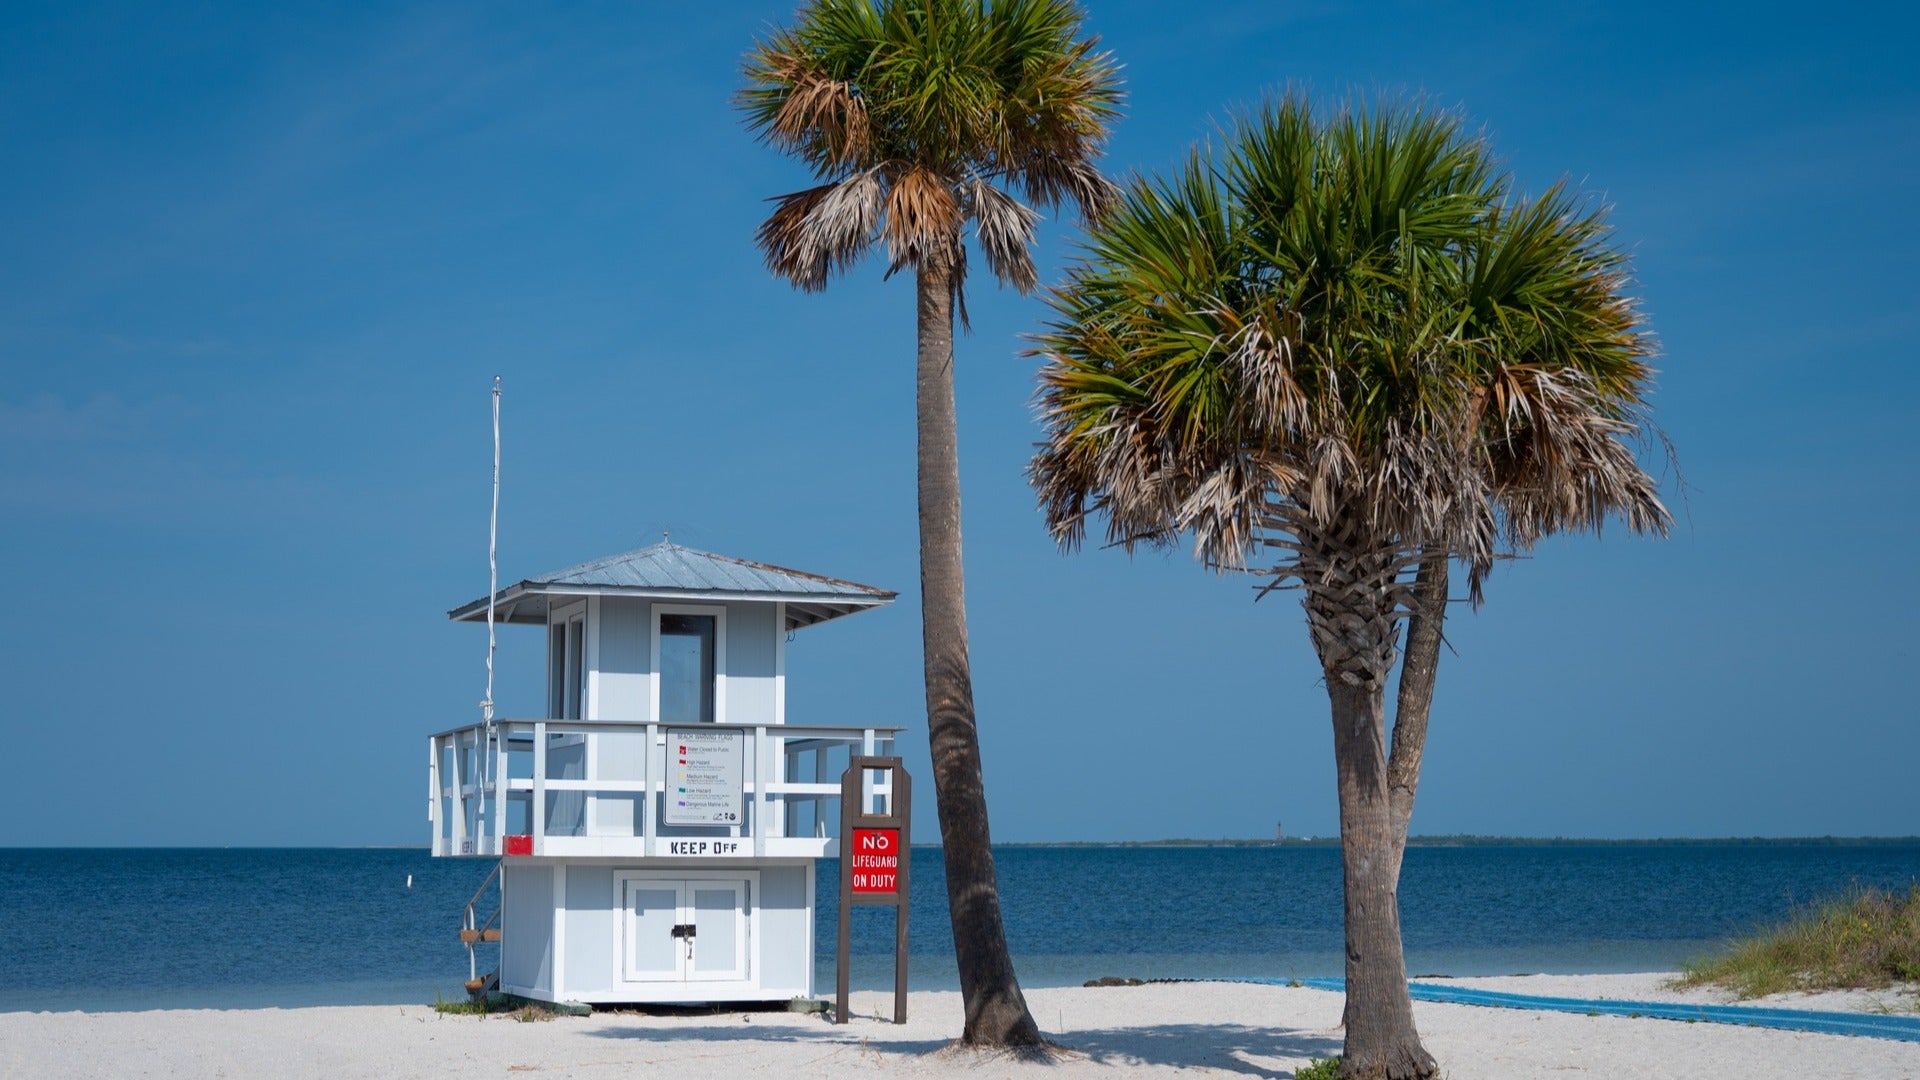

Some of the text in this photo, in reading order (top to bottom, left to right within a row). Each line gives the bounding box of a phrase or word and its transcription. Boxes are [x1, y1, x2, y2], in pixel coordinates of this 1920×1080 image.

[695, 733, 717, 741] WARNING
[671, 841, 707, 854] KEEP
[863, 836, 889, 849] NO
[852, 855, 897, 868] LIFEGUARD
[853, 874, 895, 888] ON DUTY
